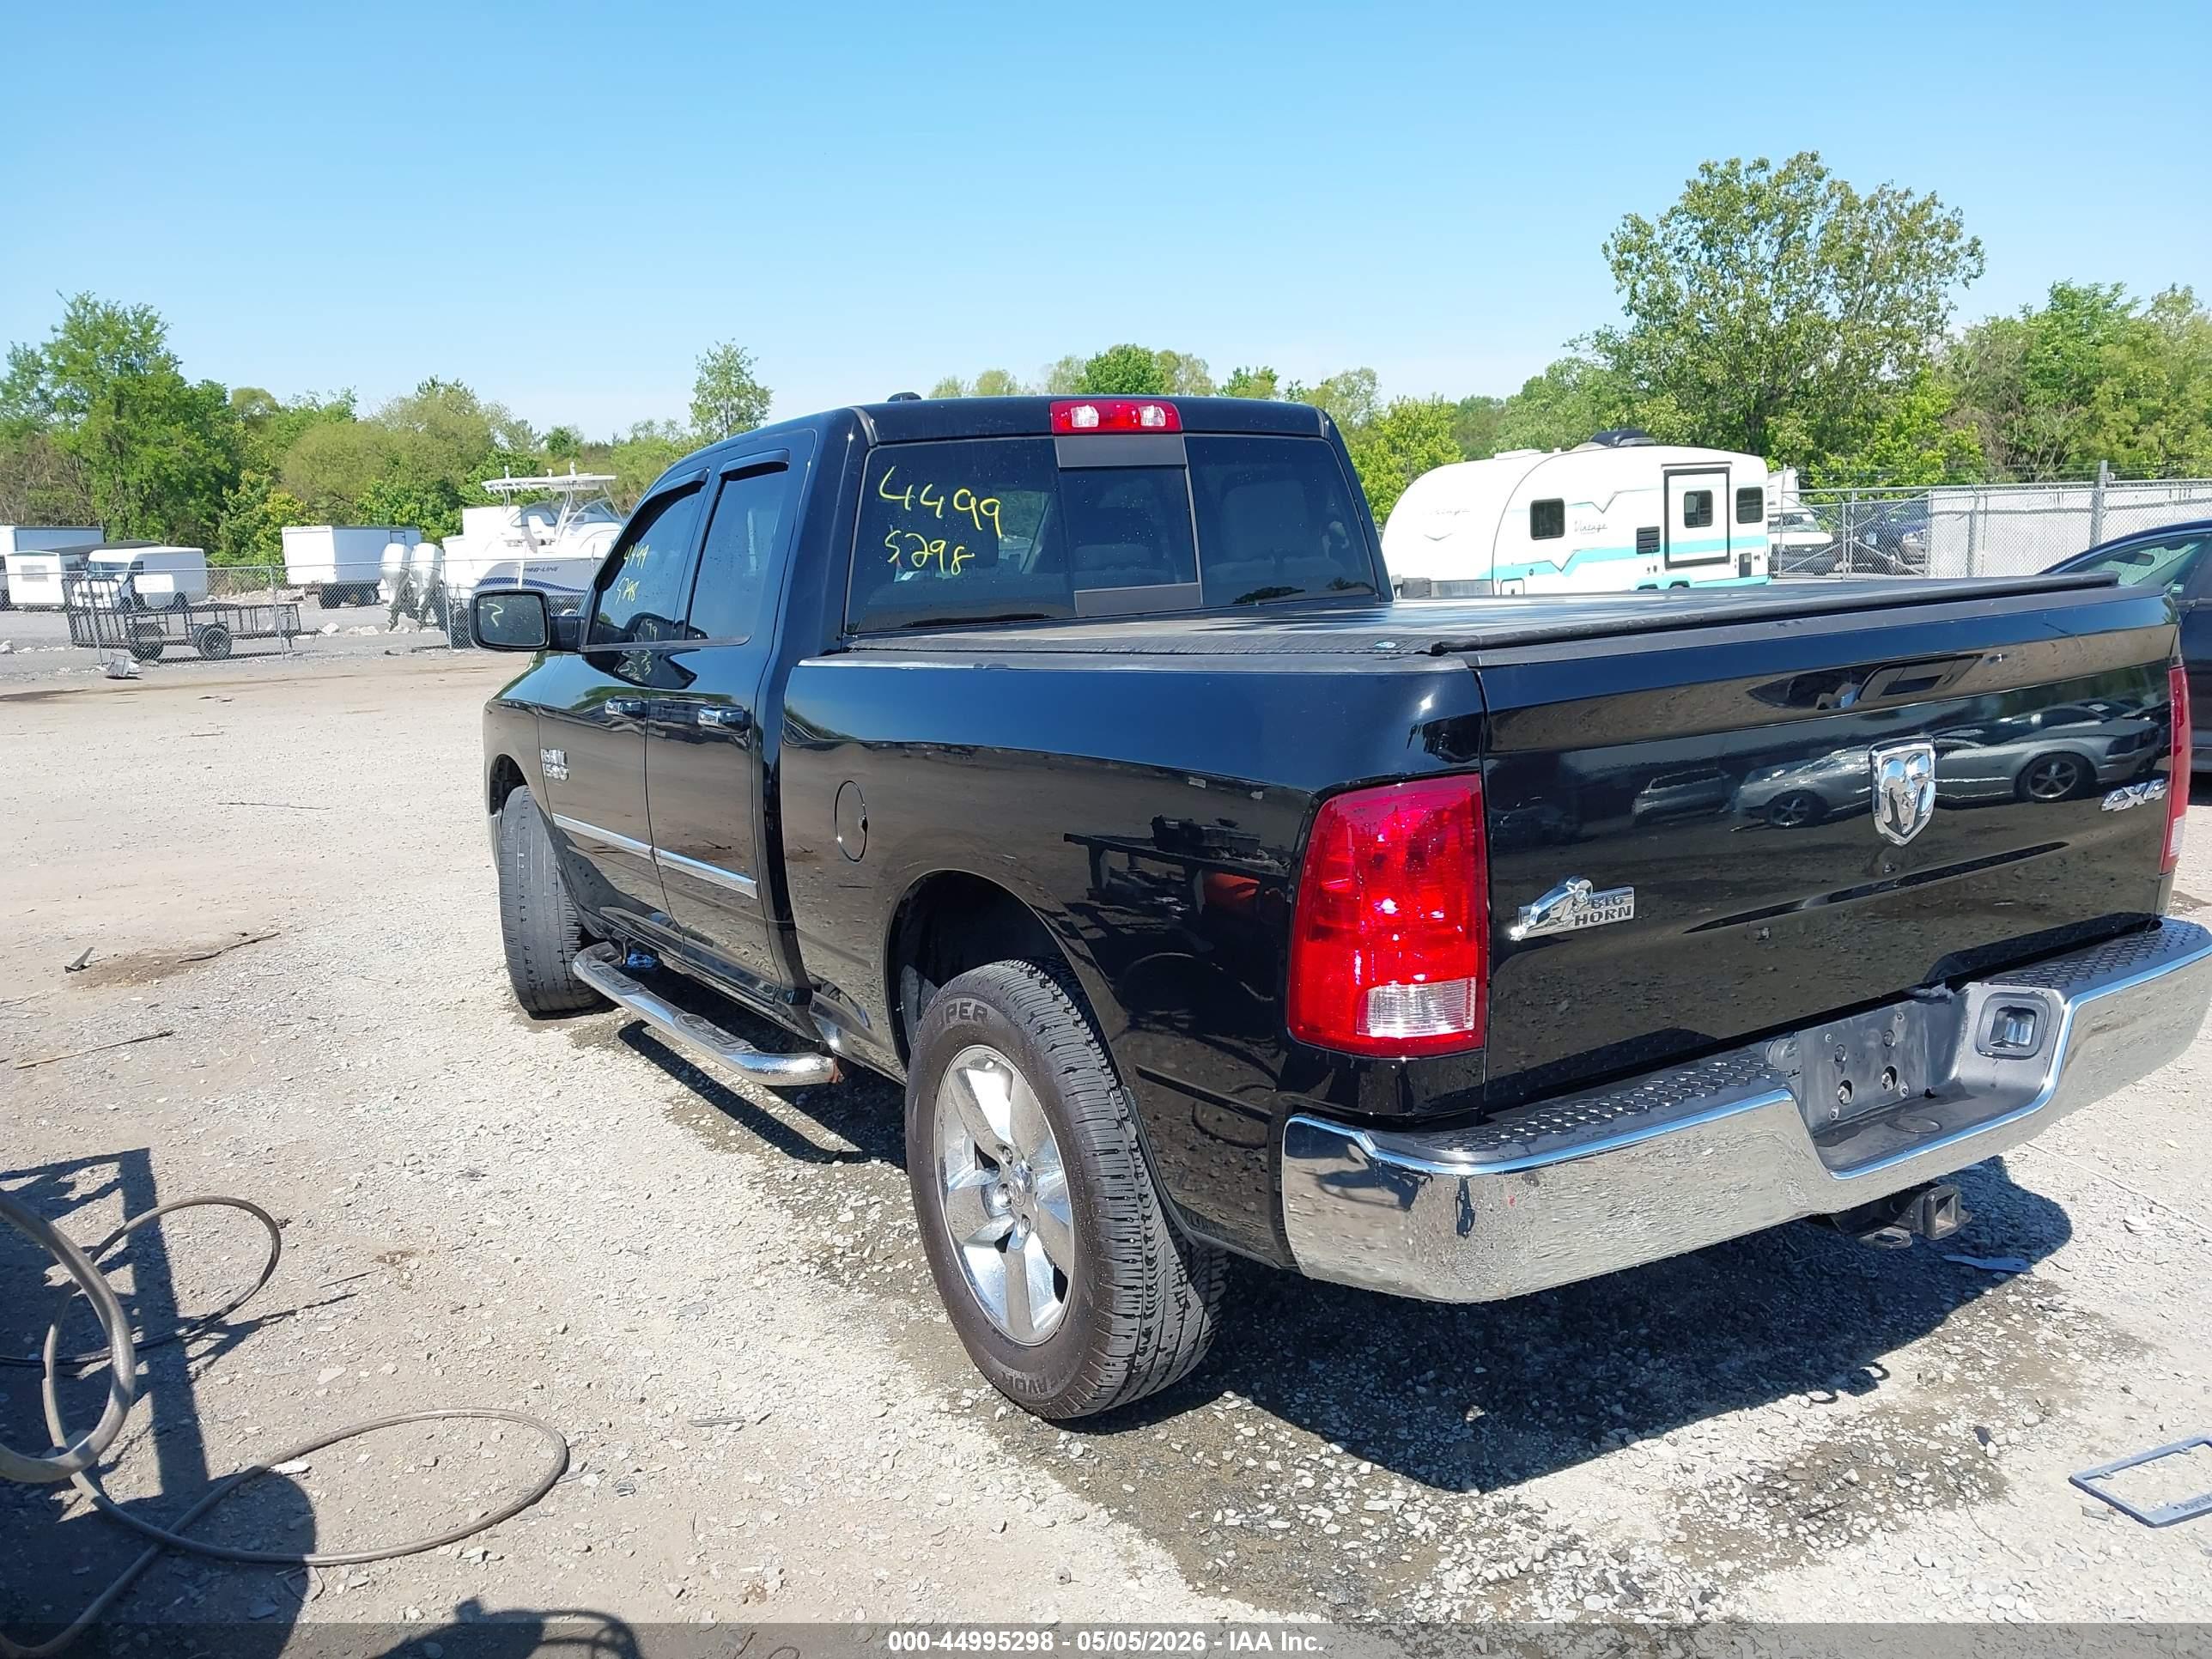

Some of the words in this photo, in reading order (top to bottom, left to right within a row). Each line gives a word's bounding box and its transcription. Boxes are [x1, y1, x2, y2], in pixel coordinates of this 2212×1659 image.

[879, 466, 1001, 538] 4499
[623, 543, 650, 570] 4499
[885, 530, 975, 575] 5298
[1590, 893, 1625, 909] BIG
[1575, 905, 1632, 927] HORN
